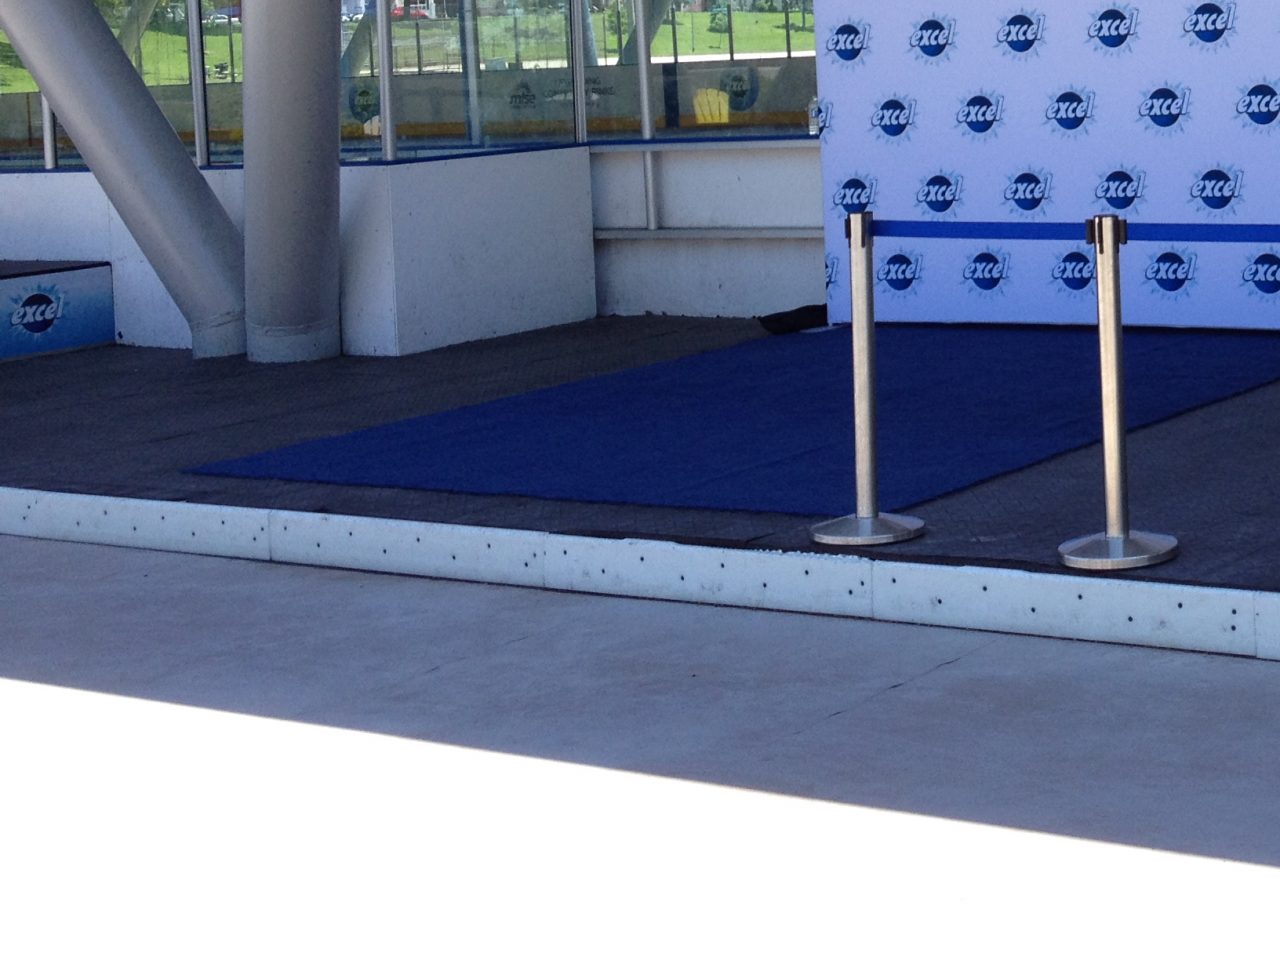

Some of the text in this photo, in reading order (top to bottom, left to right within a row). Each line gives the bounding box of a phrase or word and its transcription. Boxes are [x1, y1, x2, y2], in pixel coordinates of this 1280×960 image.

[997, 16, 1045, 43] excel
[1088, 11, 1139, 38] excel
[1183, 4, 1237, 34] excel
[827, 25, 871, 50] excel
[911, 20, 956, 48] excel
[871, 99, 917, 127] excel
[957, 96, 1004, 122] excel
[1046, 93, 1095, 121] excel
[1139, 90, 1191, 118] excel
[834, 181, 877, 206] excel
[917, 178, 963, 204] excel
[1004, 174, 1052, 203] excel
[1096, 172, 1146, 202] excel
[1191, 171, 1244, 201] excel
[877, 256, 923, 284] excel
[963, 255, 1010, 281] excel
[1145, 255, 1197, 284] excel
[10, 293, 65, 325] excel
